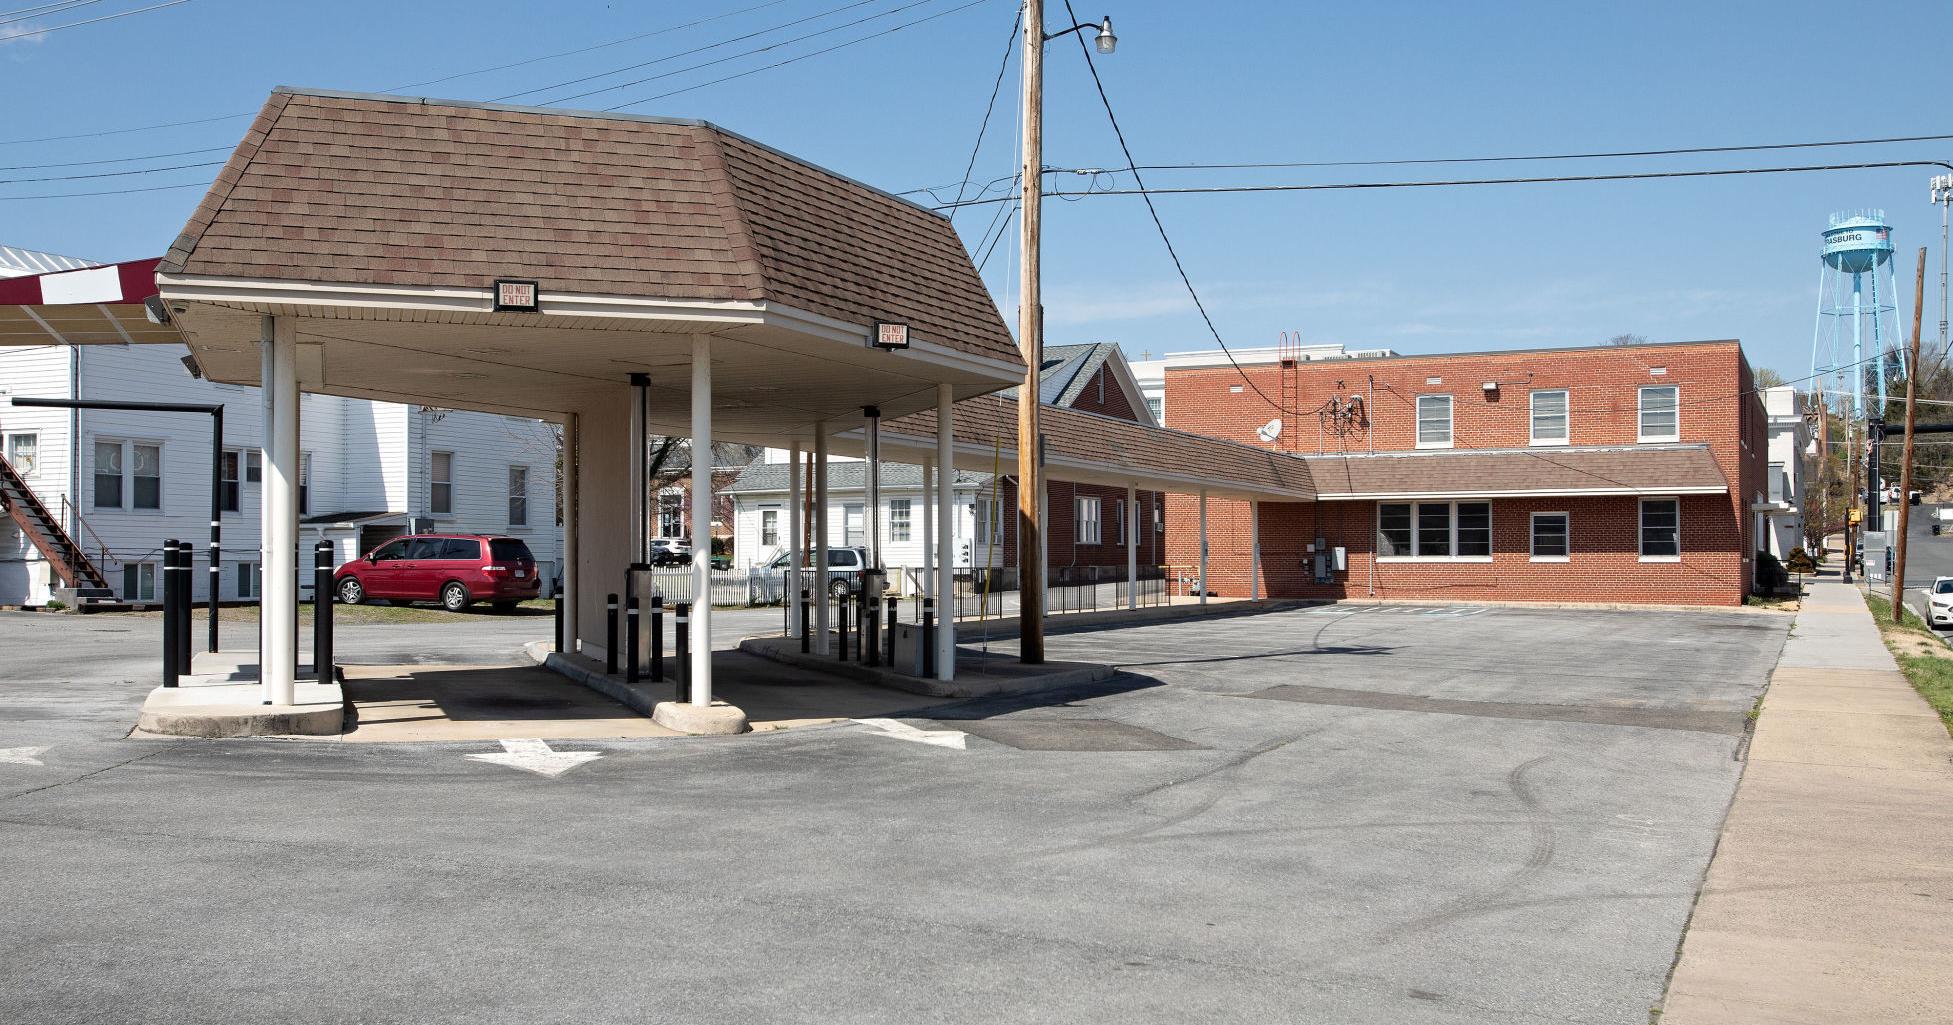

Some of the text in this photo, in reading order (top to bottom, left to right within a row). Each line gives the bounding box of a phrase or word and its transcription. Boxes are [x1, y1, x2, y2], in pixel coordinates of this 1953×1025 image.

[502, 285, 530, 295] DO NOT
[503, 295, 530, 305] ENTER
[881, 325, 904, 334] DO NOT
[881, 334, 904, 343] ENTER
